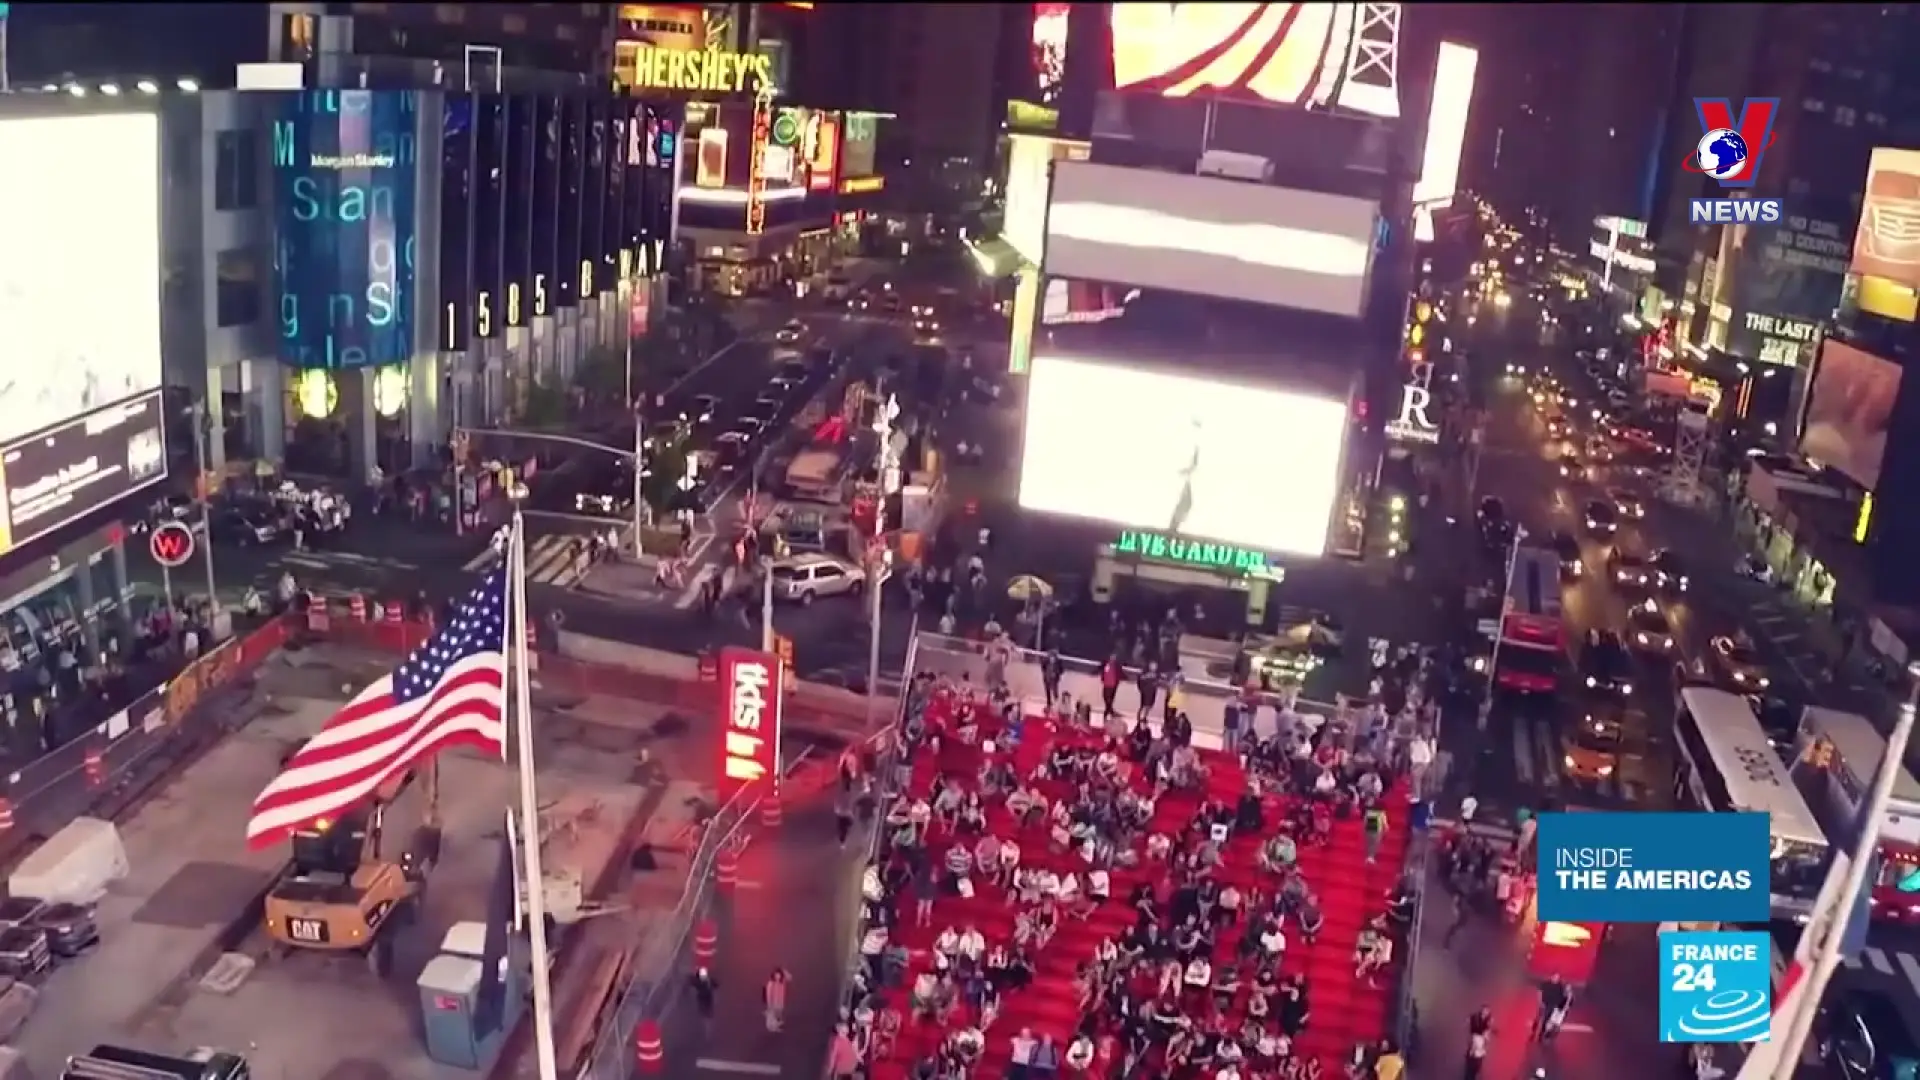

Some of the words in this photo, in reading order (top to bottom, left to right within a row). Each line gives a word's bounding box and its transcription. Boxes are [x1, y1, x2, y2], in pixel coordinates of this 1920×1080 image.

[636, 47, 770, 91] HERSHEY'S
[1746, 312, 1774, 333] THE
[1776, 318, 1813, 341] LAST
[1399, 385, 1439, 430] R
[291, 918, 321, 940] CAT
